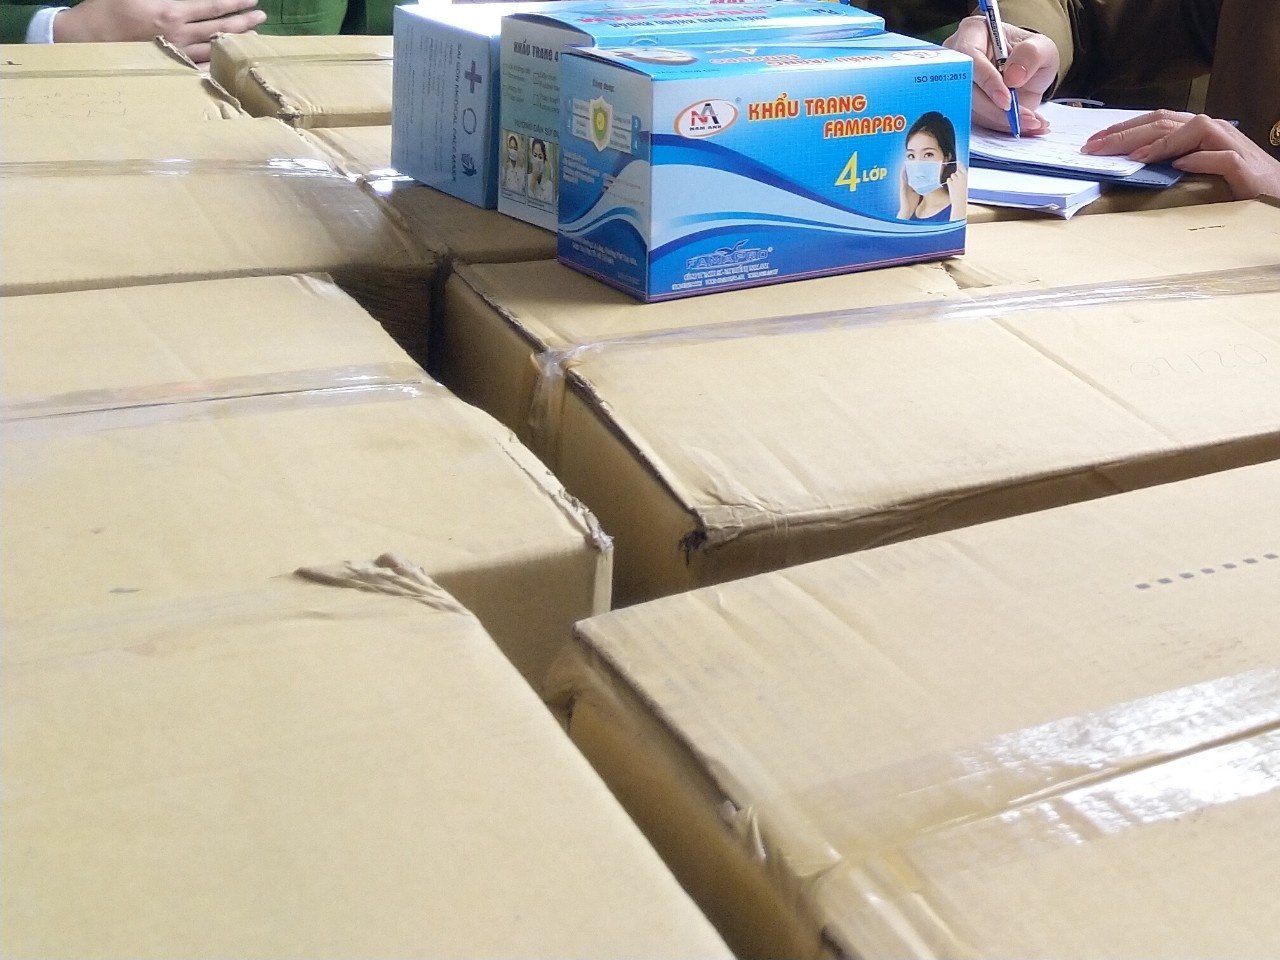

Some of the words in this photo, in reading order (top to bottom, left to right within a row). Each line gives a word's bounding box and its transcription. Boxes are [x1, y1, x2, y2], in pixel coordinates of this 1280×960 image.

[914, 75, 929, 84] ISO
[748, 92, 799, 121] KHẨU
[804, 94, 868, 116] TRANG
[823, 115, 907, 140] FAMAPRO
[834, 150, 861, 192] 4
[862, 164, 888, 182] LỚP
